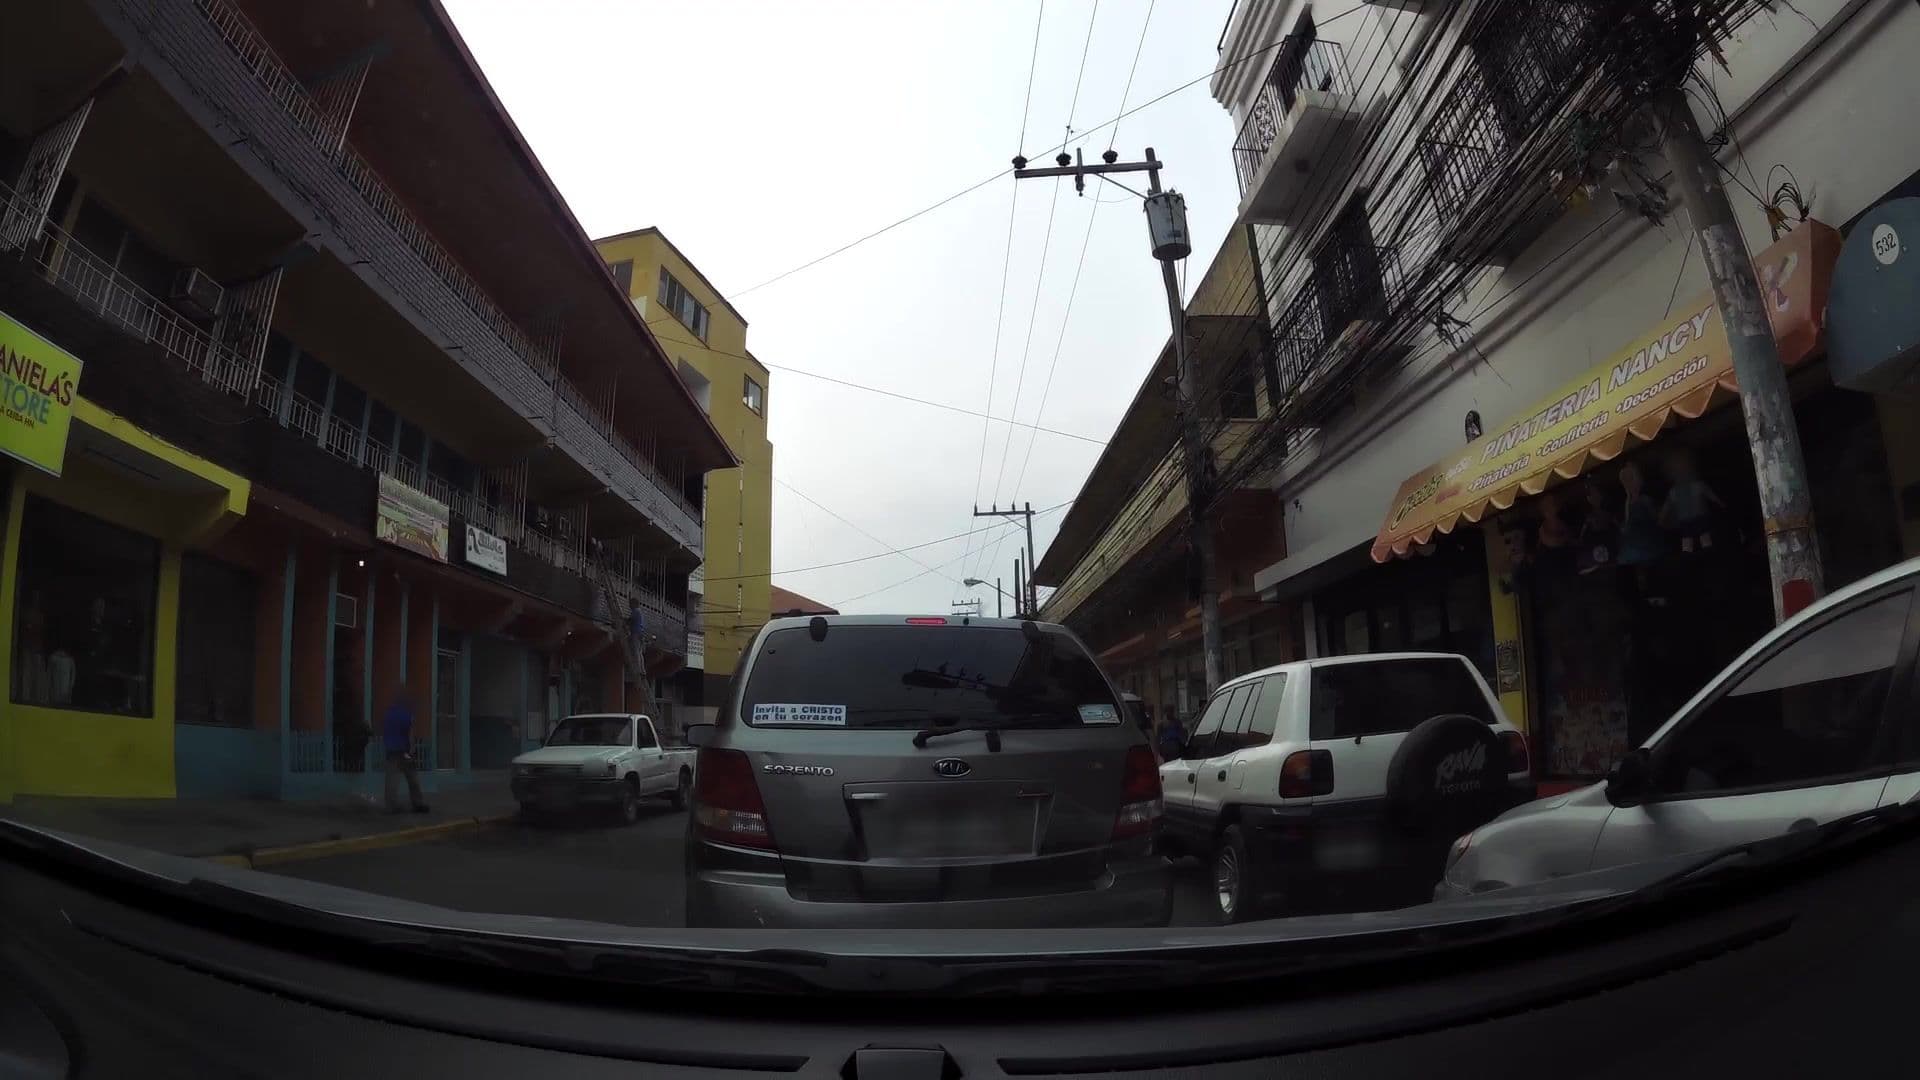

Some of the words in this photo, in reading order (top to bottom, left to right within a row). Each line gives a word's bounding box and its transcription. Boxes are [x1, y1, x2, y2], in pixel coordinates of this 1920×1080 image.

[1876, 233, 1896, 256] 532
[1606, 304, 1713, 394] NANCY
[755, 705, 785, 714] Invita
[801, 706, 842, 715] CRISTO
[763, 764, 834, 776] SORENTO
